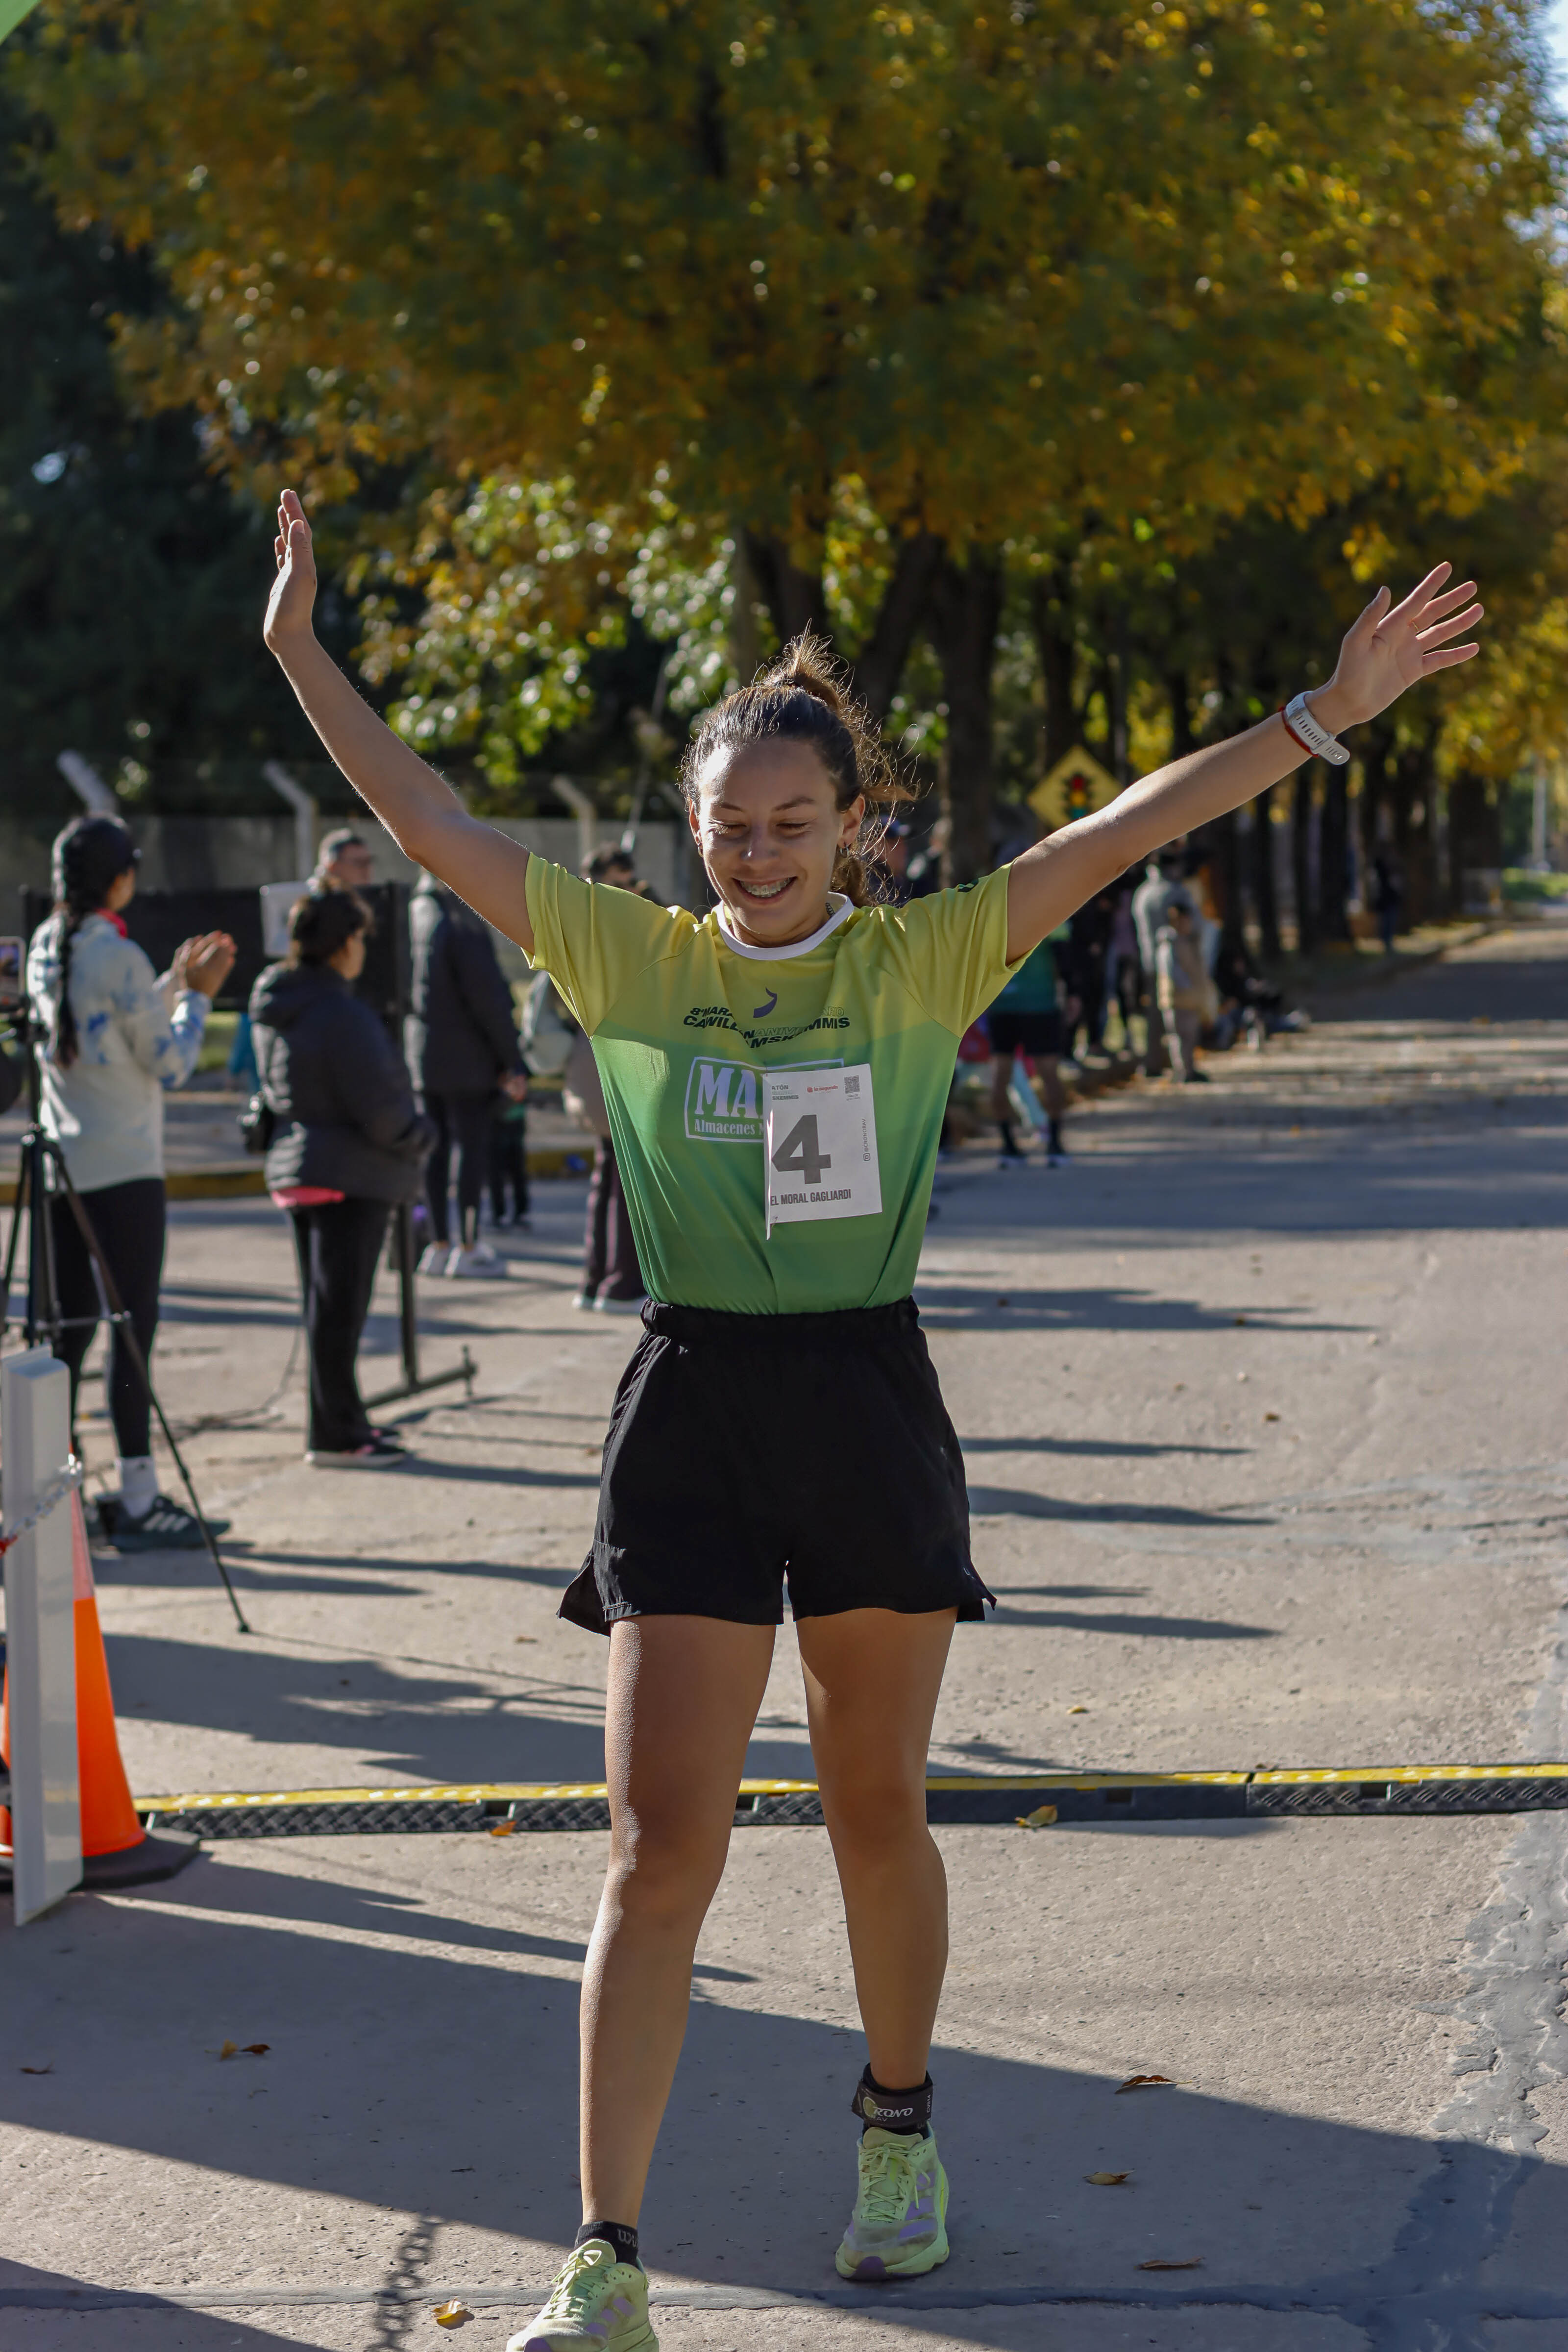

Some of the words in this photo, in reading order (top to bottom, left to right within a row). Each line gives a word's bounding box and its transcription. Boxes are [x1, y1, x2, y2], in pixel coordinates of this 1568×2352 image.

[694, 1119, 756, 1135] Almacenes
[771, 1114, 832, 1184] 4
[781, 1193, 808, 1205] MORAL
[810, 1189, 852, 1202] GAGLIARDI
